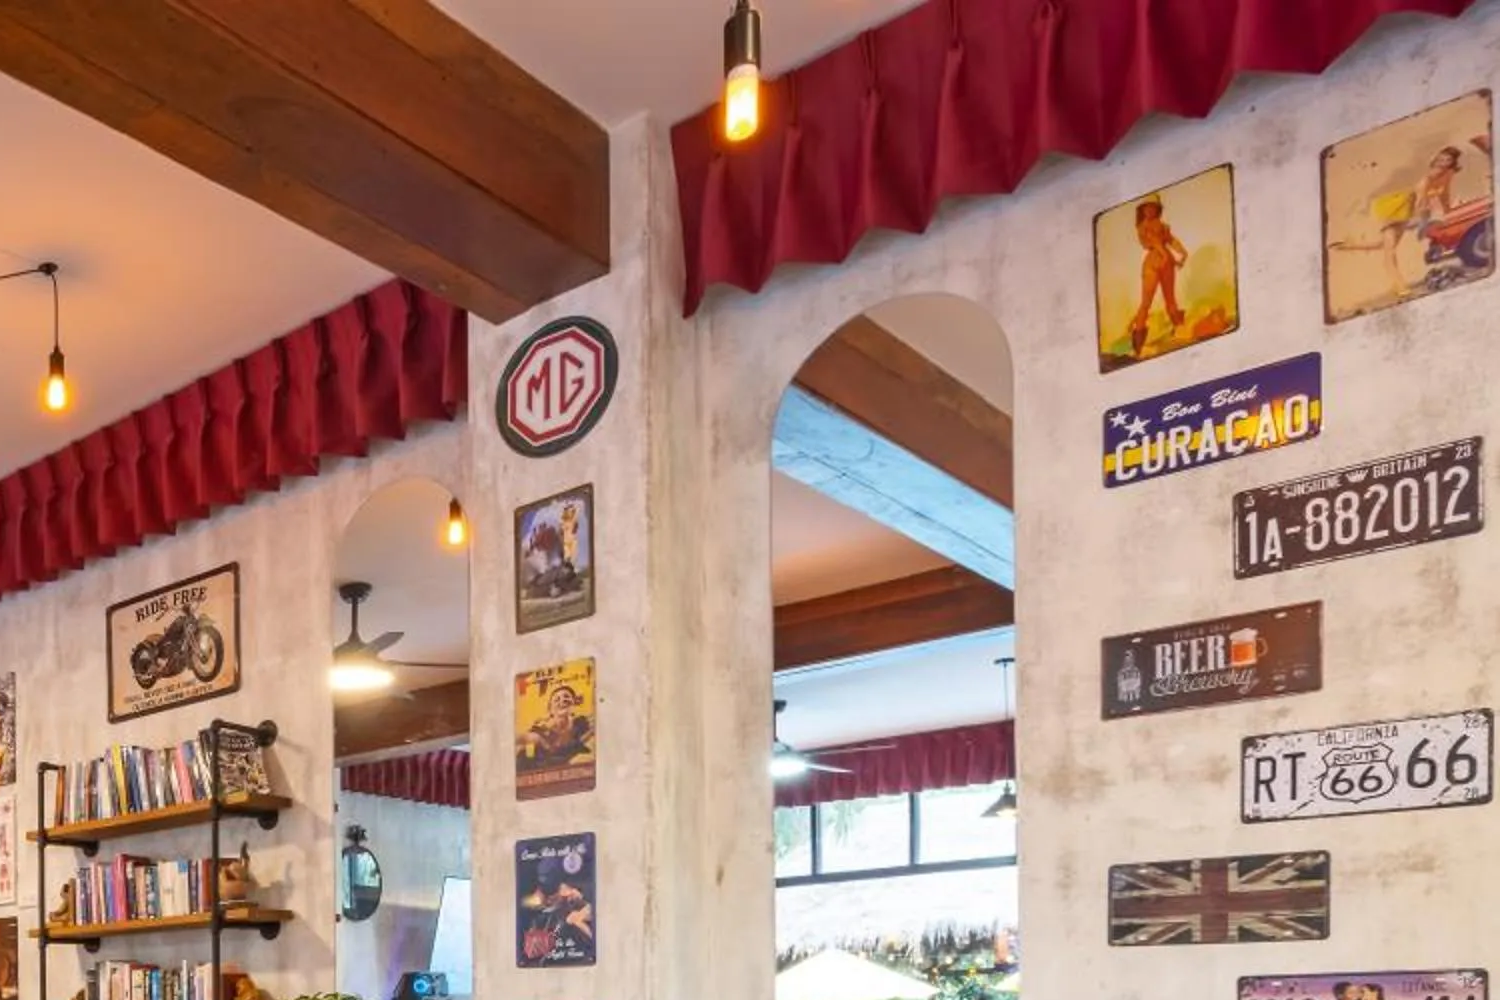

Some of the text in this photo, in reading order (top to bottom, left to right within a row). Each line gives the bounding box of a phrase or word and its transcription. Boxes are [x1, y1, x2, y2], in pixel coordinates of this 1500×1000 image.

[526, 351, 585, 420] MG
[1162, 402, 1203, 421] Bon
[1373, 453, 1428, 478] BRITAIN
[134, 586, 208, 623] RIDE FREE
[1155, 634, 1226, 678] BEER
[1317, 724, 1399, 747] CALIFORNIA
[1253, 734, 1478, 803] RT 66
[1334, 749, 1380, 763] ROUTE
[1330, 765, 1383, 796] 66
